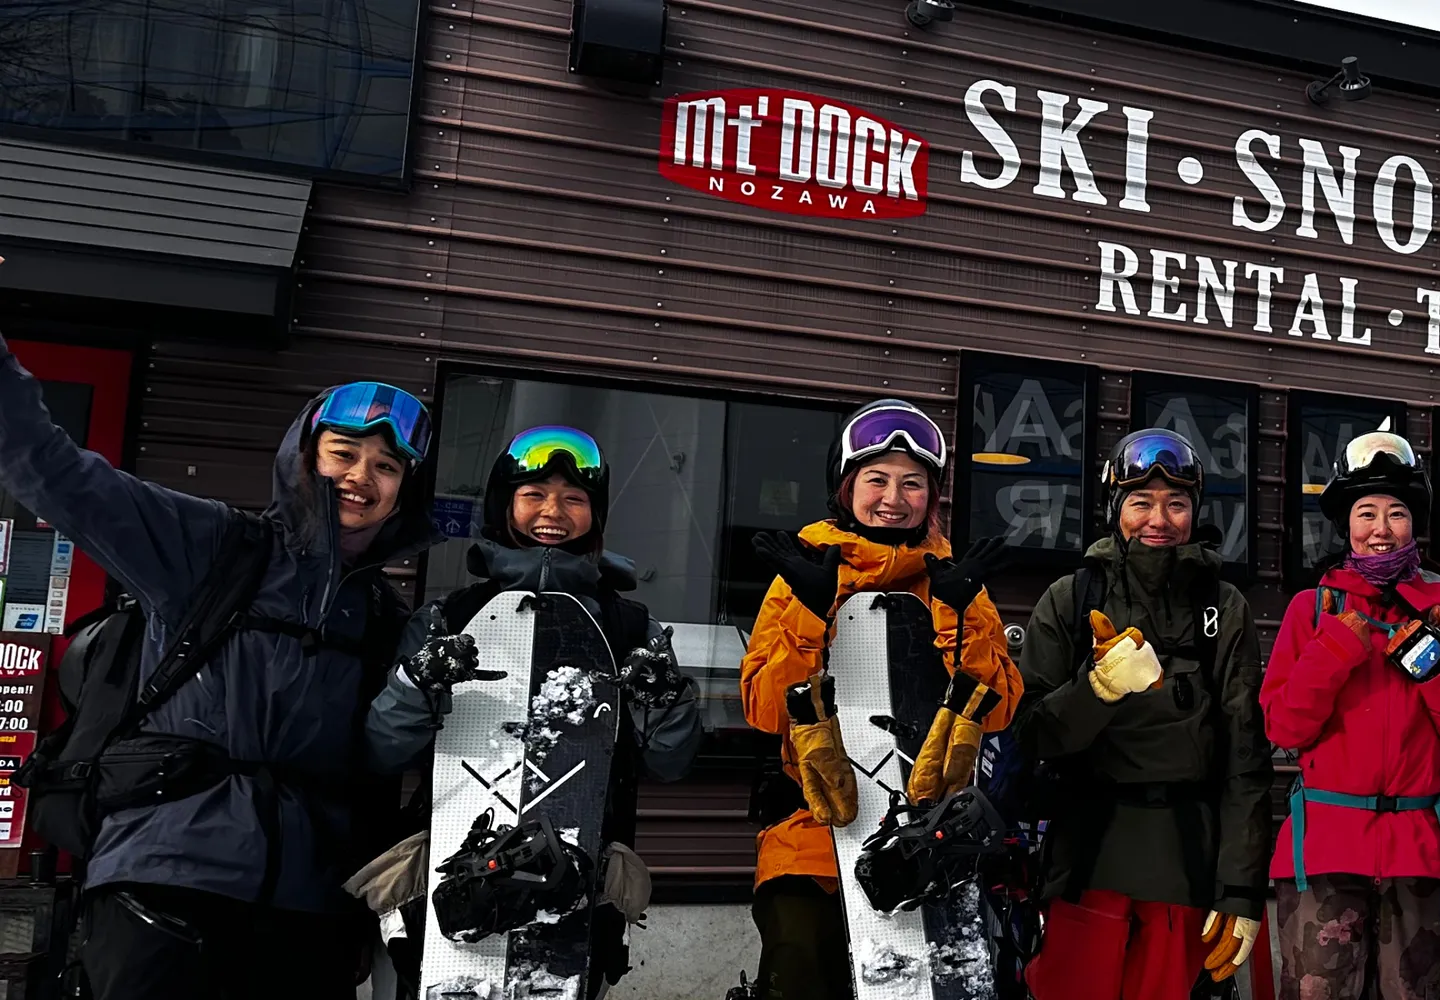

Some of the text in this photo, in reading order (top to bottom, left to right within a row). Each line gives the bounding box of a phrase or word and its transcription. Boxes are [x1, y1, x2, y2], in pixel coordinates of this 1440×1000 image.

[709, 176, 877, 214] NOZAWA
[779, 97, 922, 201] DOCK
[960, 79, 1155, 212] SKI
[1095, 241, 1372, 346] RENTAL
